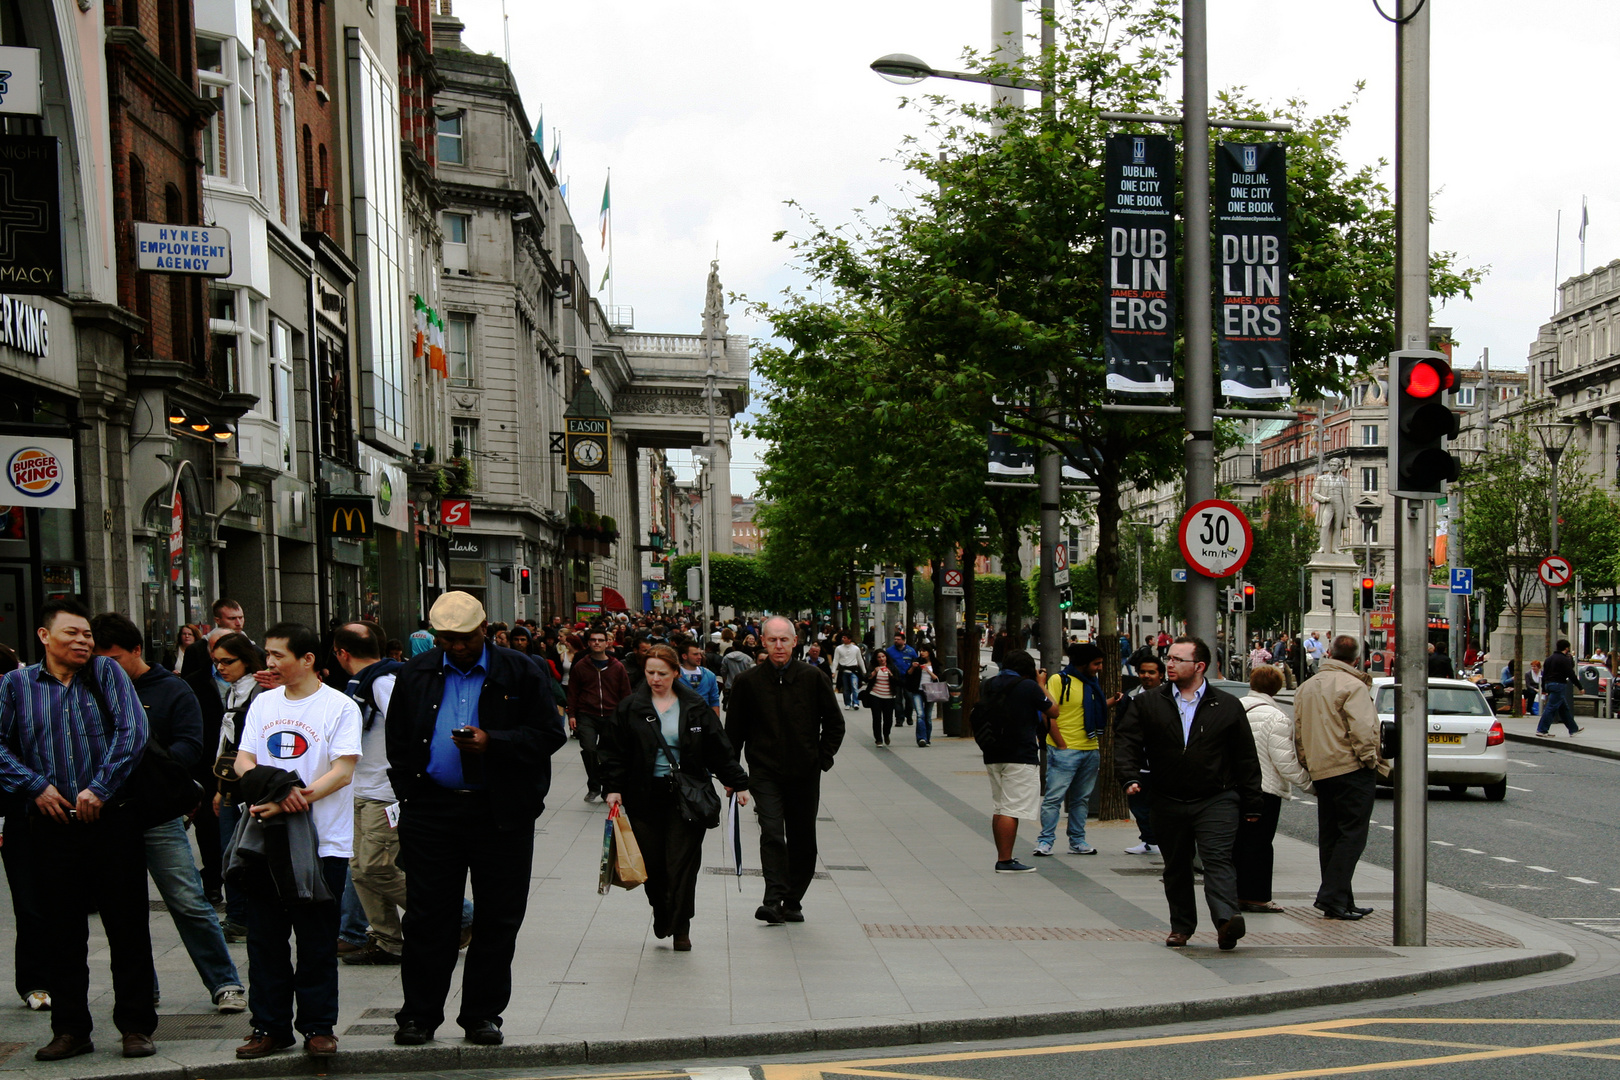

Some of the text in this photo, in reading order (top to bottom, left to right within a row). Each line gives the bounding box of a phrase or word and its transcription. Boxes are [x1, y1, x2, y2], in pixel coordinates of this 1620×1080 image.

[1122, 165, 1158, 178] DUBLIN:
[1232, 172, 1269, 185] DUBLIN:
[1120, 180, 1160, 192] ONE CITY
[1230, 187, 1271, 199] ONE CITY
[1117, 194, 1163, 207] ONE BOOK
[1227, 201, 1274, 213] ONE BOOK
[160, 228, 209, 243] HYNES
[1111, 226, 1167, 259] DUB
[140, 241, 226, 258] EMPLOYMENT
[1222, 234, 1280, 265] DUB
[156, 256, 210, 271] AGENCY
[1110, 257, 1167, 291] LIN
[1222, 265, 1280, 297] LIN
[1110, 289, 1167, 299] JAMES JOYCE
[1222, 296, 1280, 305] JAMES JOYCE
[1110, 297, 1168, 330] ERS
[1223, 304, 1282, 336] ERS
[15, 299, 49, 359] KING
[570, 420, 605, 433] EASON
[13, 456, 56, 473] BURGER
[16, 465, 58, 485] KING
[1200, 513, 1230, 546] 30
[1202, 548, 1228, 559] km/h
[1456, 569, 1467, 582] P
[889, 579, 899, 590] P
